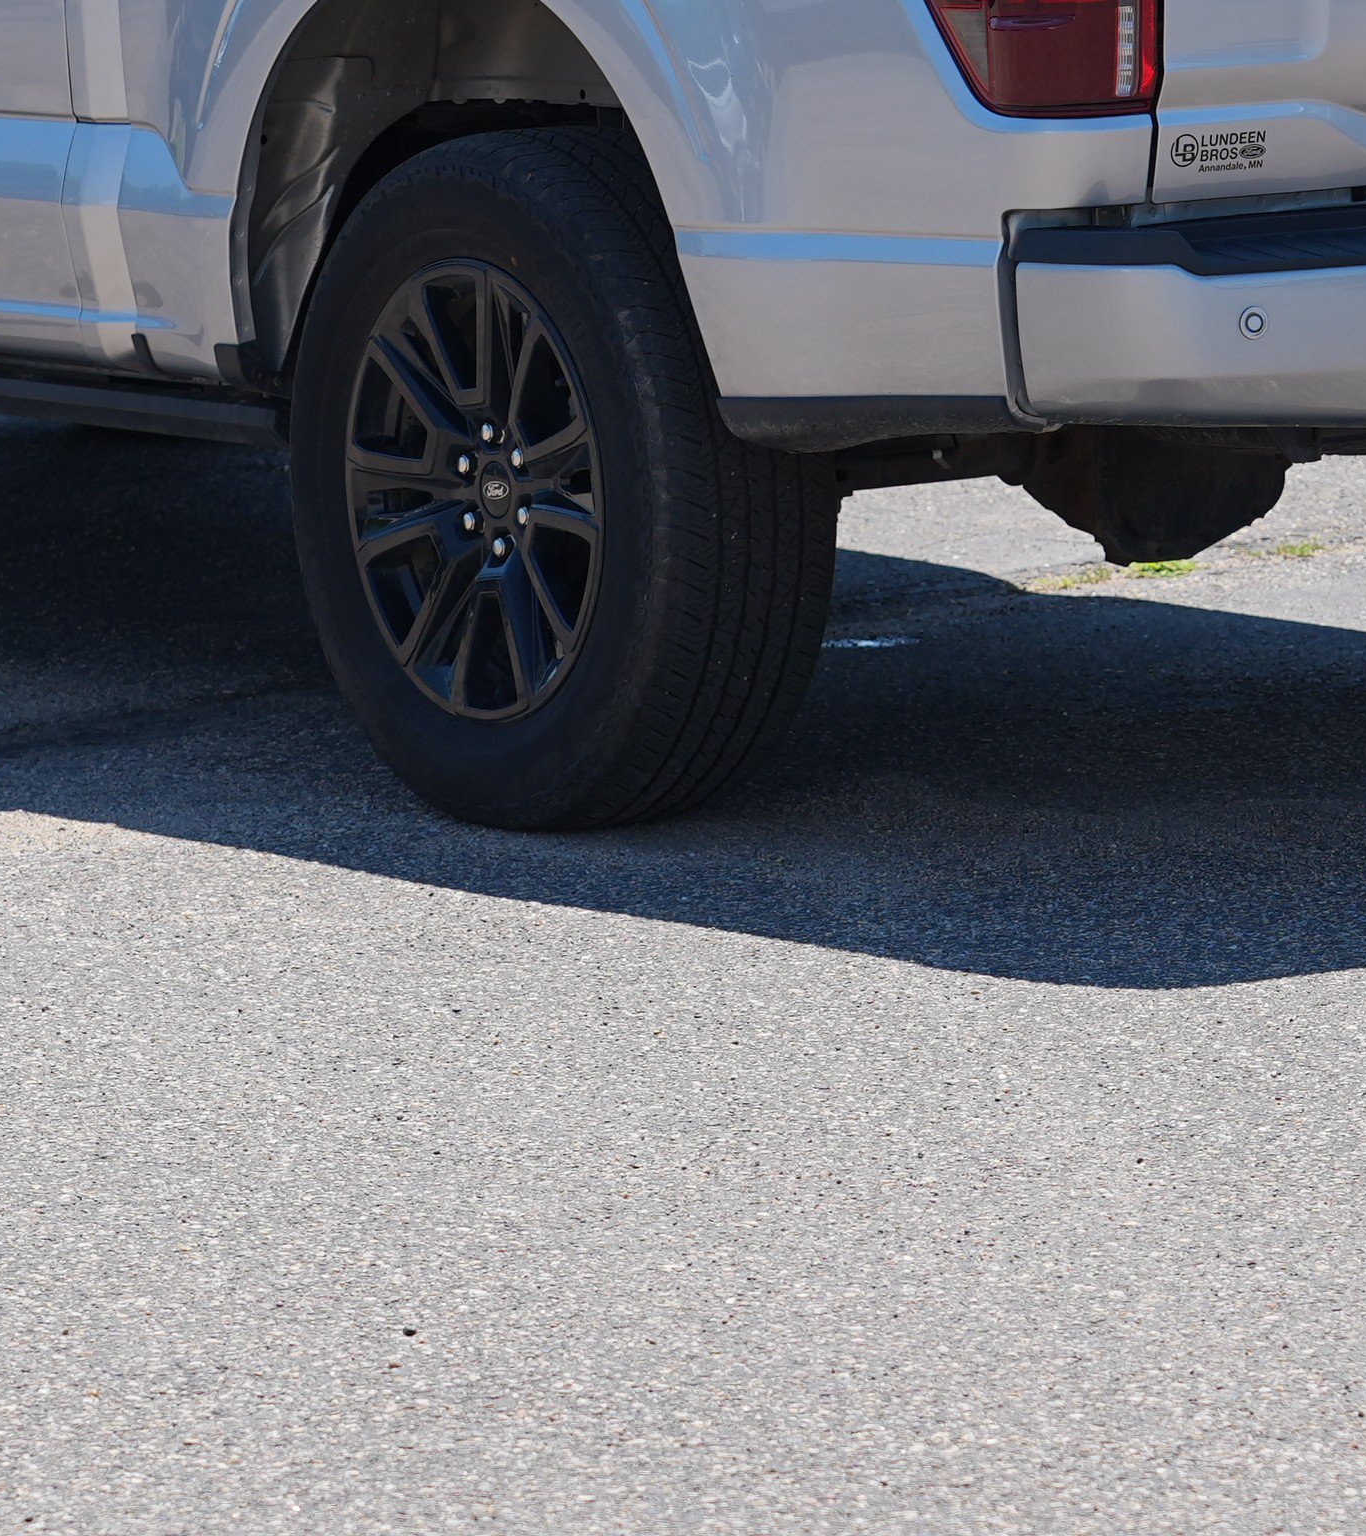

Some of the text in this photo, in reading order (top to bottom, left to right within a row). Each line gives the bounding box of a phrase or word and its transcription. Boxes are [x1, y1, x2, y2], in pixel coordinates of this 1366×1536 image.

[1201, 130, 1266, 147] LUNDEEN
[1200, 147, 1238, 162] BROS
[1198, 160, 1263, 173] Annandale, MN
